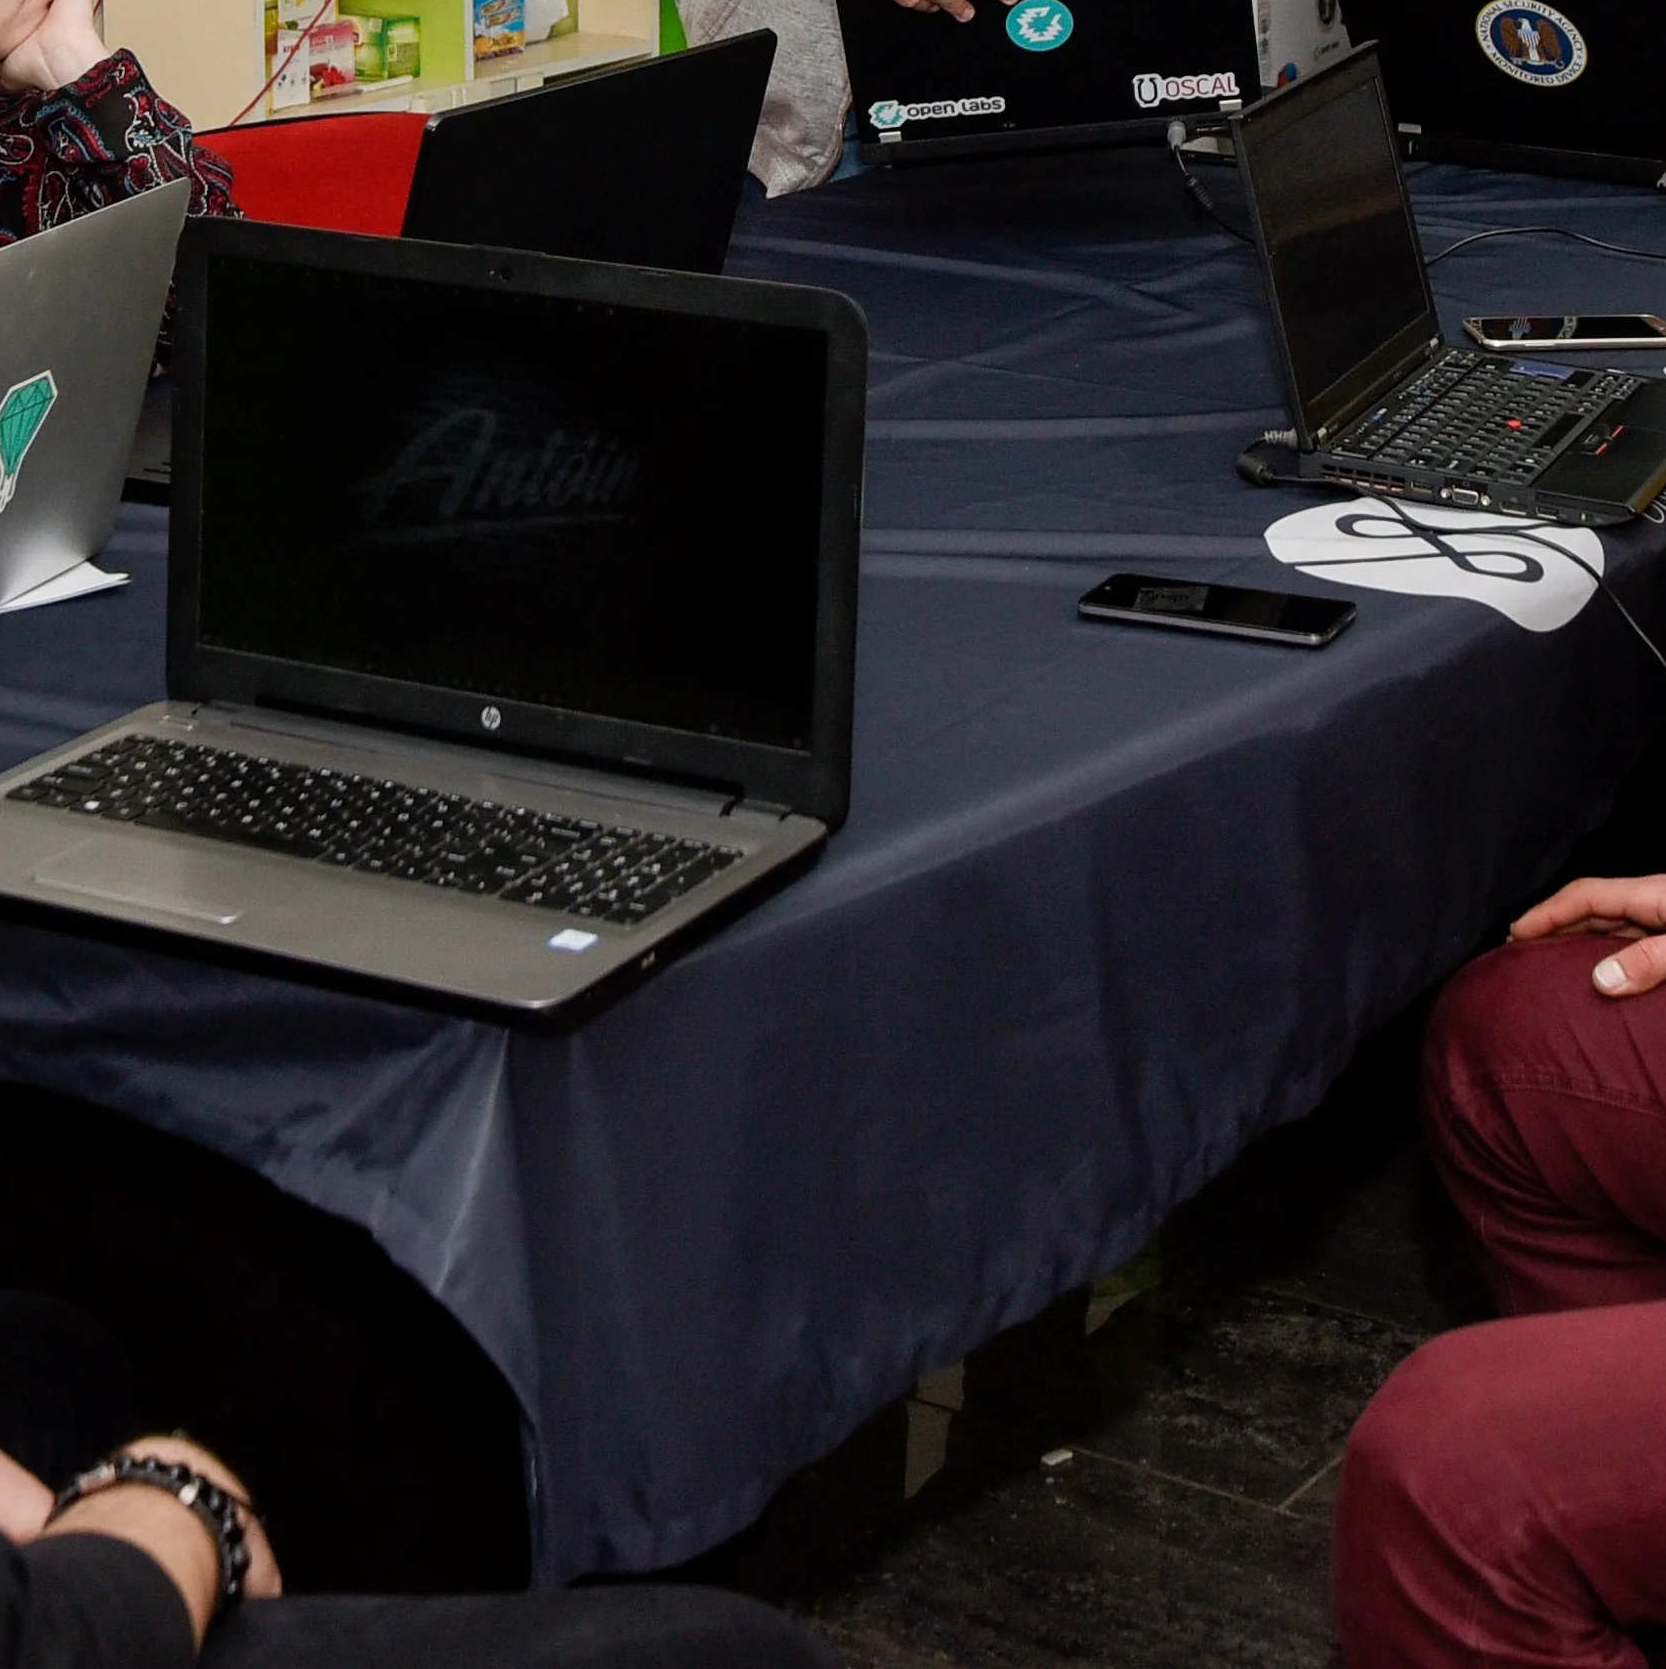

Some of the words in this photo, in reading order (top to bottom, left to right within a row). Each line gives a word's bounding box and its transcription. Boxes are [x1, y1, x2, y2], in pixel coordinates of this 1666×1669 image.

[1503, 0, 1554, 17] SECURITY
[1480, 3, 1503, 42] NATIONAL
[1555, 16, 1583, 51] AGENCY
[1491, 51, 1554, 84] MONITORED
[1556, 60, 1582, 83] DEVICE
[1165, 77, 1235, 98] OSCAL
[907, 103, 955, 118] open
